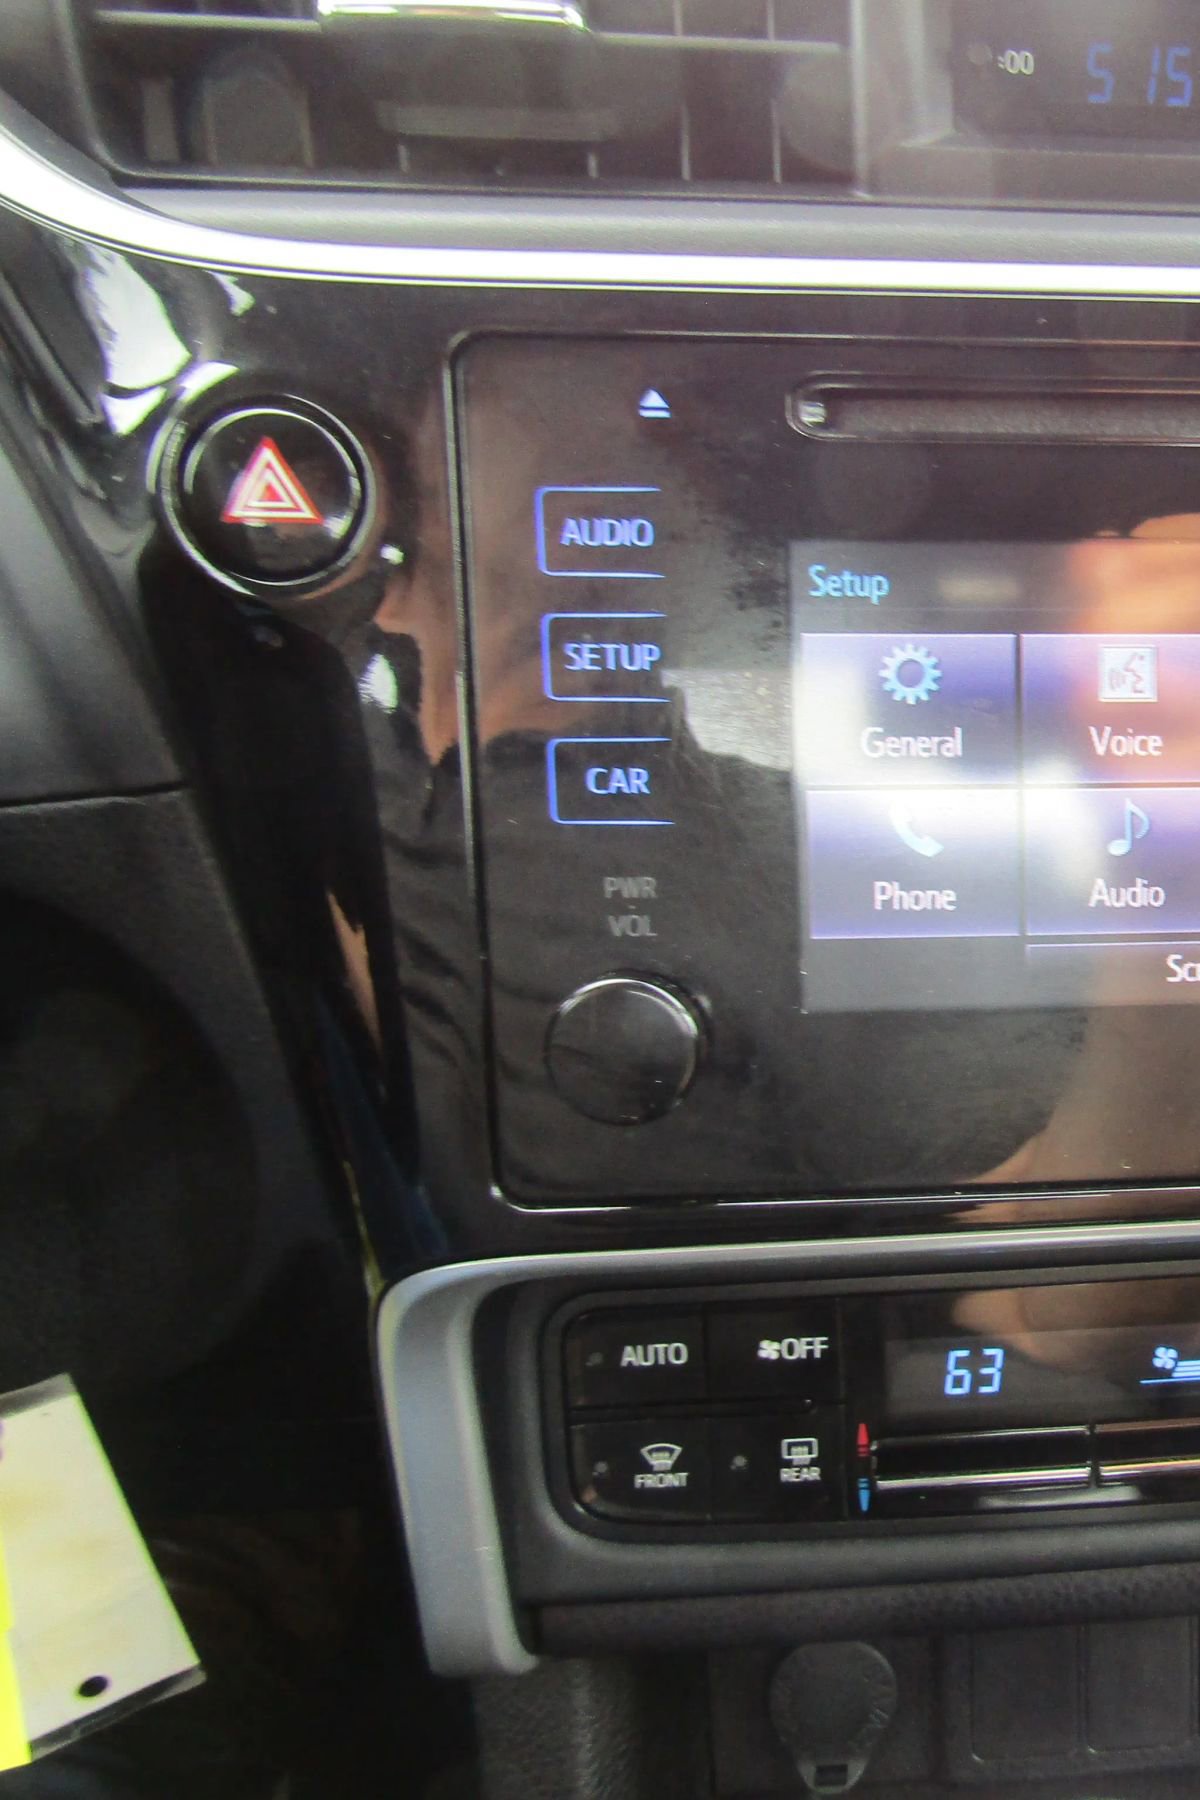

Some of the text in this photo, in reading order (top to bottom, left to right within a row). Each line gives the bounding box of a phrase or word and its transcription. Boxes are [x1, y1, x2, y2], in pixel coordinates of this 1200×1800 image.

[560, 517, 655, 547] AUDIO
[808, 564, 890, 604] Setup
[564, 643, 662, 671] SETUP
[860, 727, 963, 758] General
[1088, 726, 1164, 757] Voice
[585, 767, 651, 795] CAR
[603, 876, 658, 899] PWR
[873, 880, 957, 911] Phone
[1088, 878, 1166, 909] Audio
[608, 915, 658, 938] VOL
[620, 1342, 689, 1367] AUTO
[780, 1336, 829, 1361] OFF
[944, 1348, 1004, 1396] 63
[634, 1472, 689, 1488] FRONT
[780, 1466, 821, 1482] REAR
